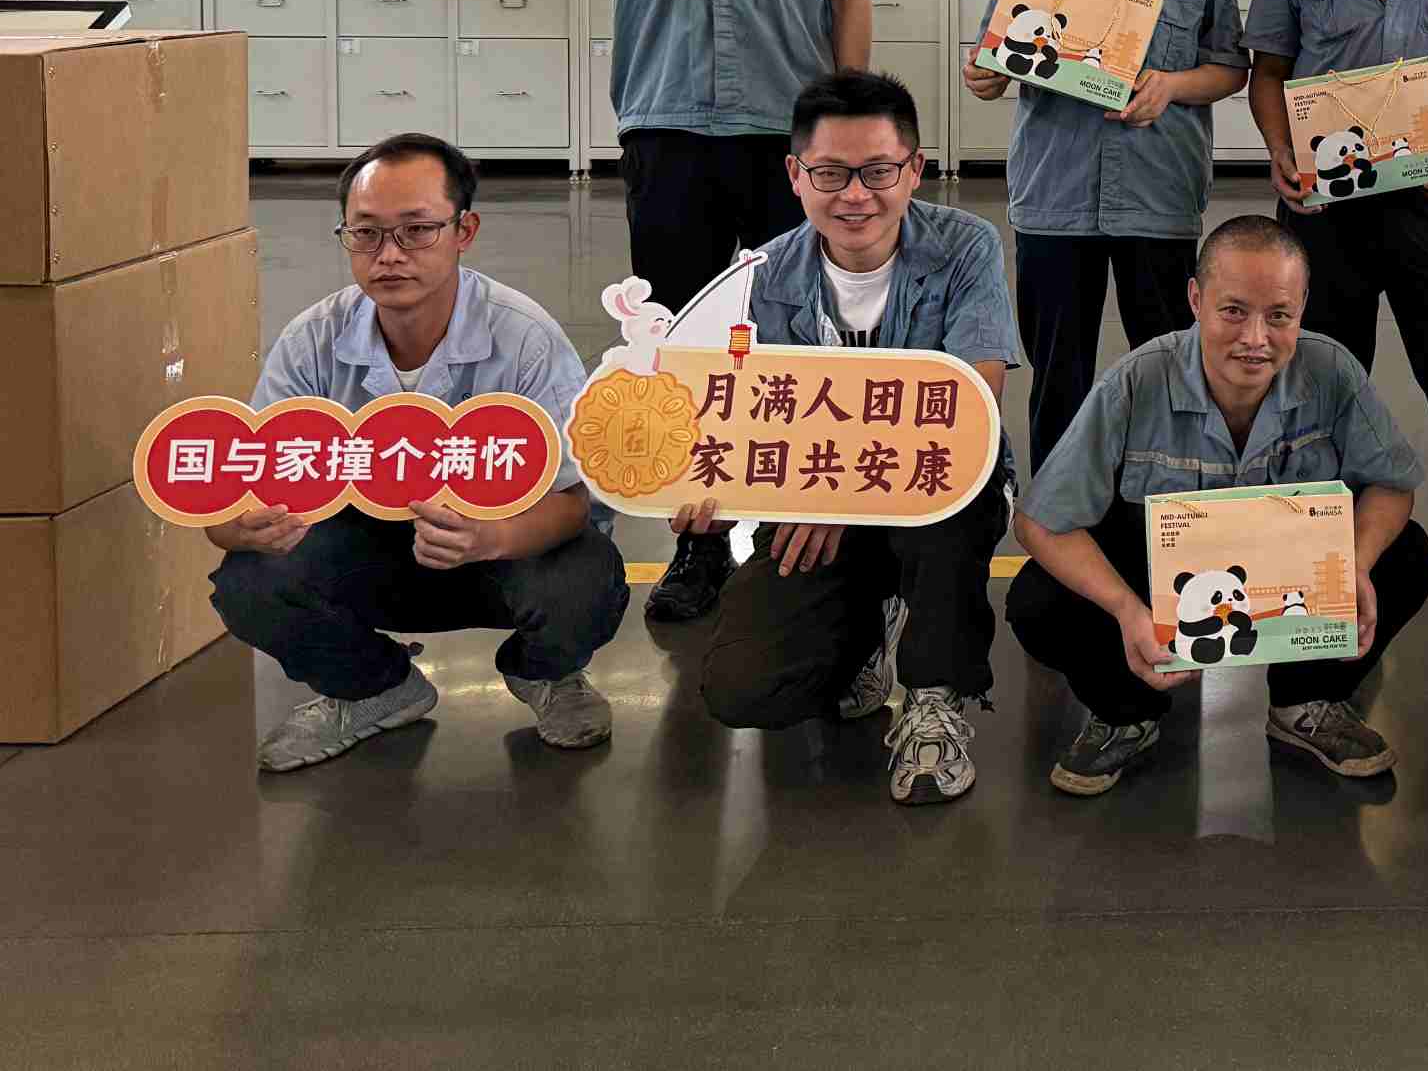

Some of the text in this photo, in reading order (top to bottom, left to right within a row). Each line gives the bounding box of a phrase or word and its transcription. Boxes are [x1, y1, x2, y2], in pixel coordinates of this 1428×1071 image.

[1079, 79, 1102, 94] MOON
[1103, 85, 1122, 99] CAKE
[1401, 168, 1423, 178] MOON
[694, 371, 960, 429] 月满人团圆
[166, 434, 529, 484] 国与家撞个满怀
[688, 435, 955, 497] 家国共安康
[1160, 522, 1191, 530] FESTIVAL
[1290, 634, 1348, 646] MOON CAKE
